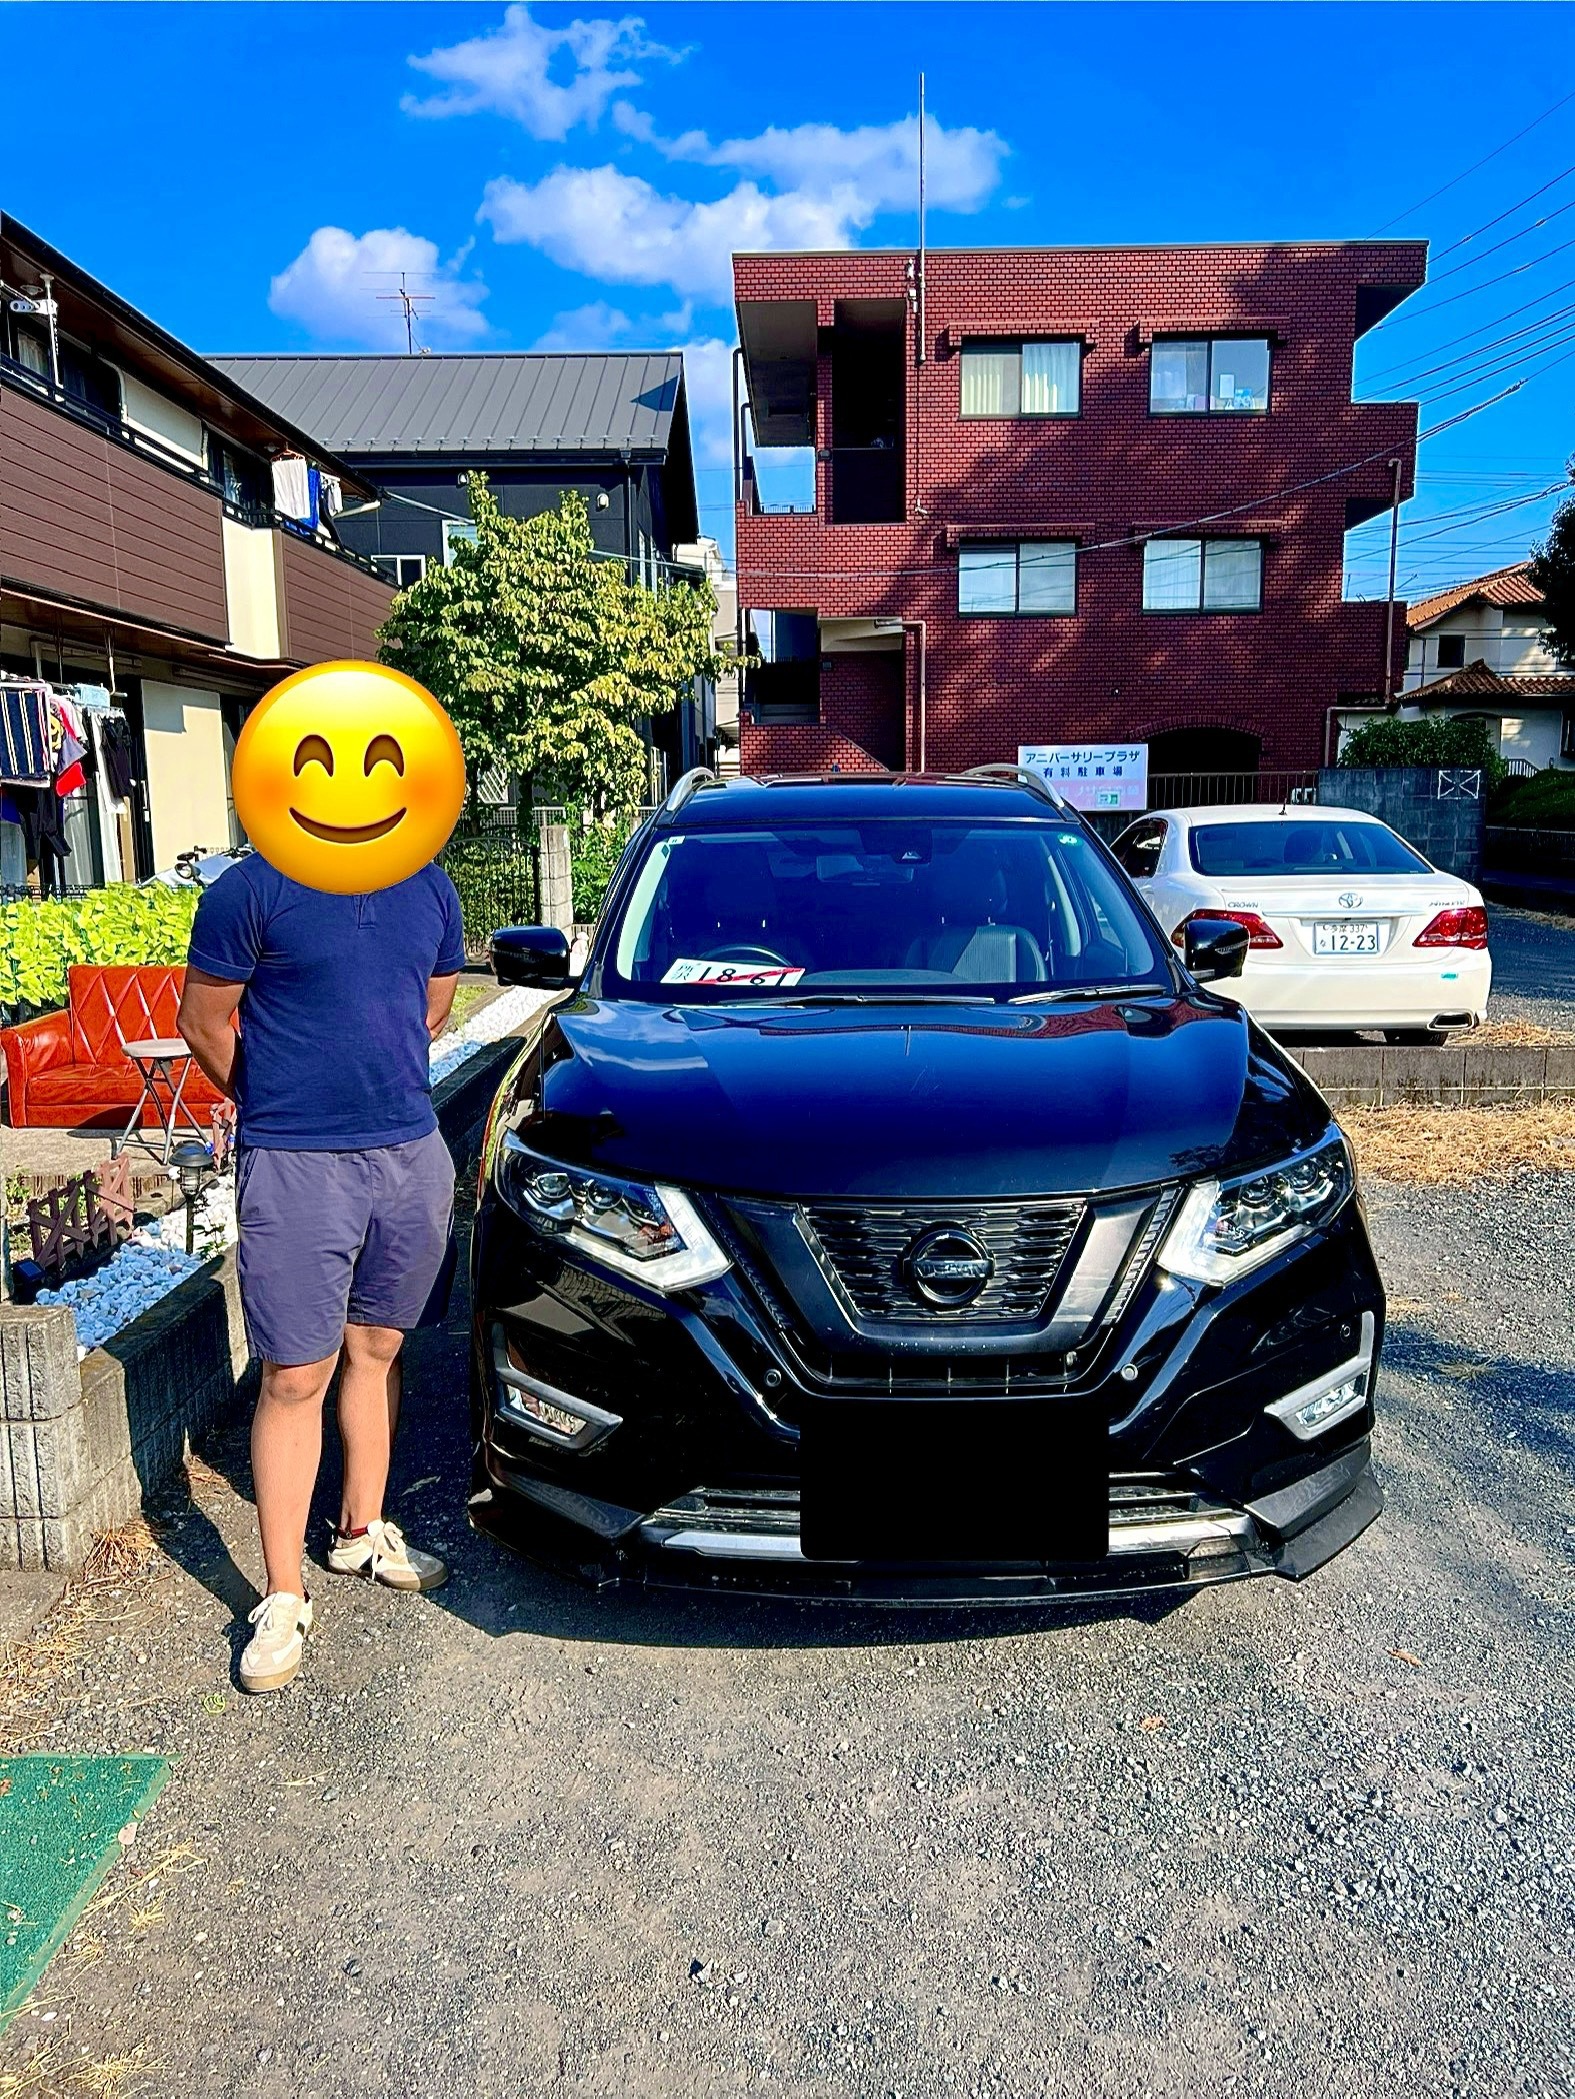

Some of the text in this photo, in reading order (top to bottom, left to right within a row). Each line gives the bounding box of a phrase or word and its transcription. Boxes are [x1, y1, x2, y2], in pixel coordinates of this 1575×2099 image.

[1025, 750, 1140, 763] アニバーサリープラザ
[1043, 766, 1123, 778] 有料駐車場
[1349, 924, 1365, 933] 337
[1331, 934, 1376, 951] 12-23
